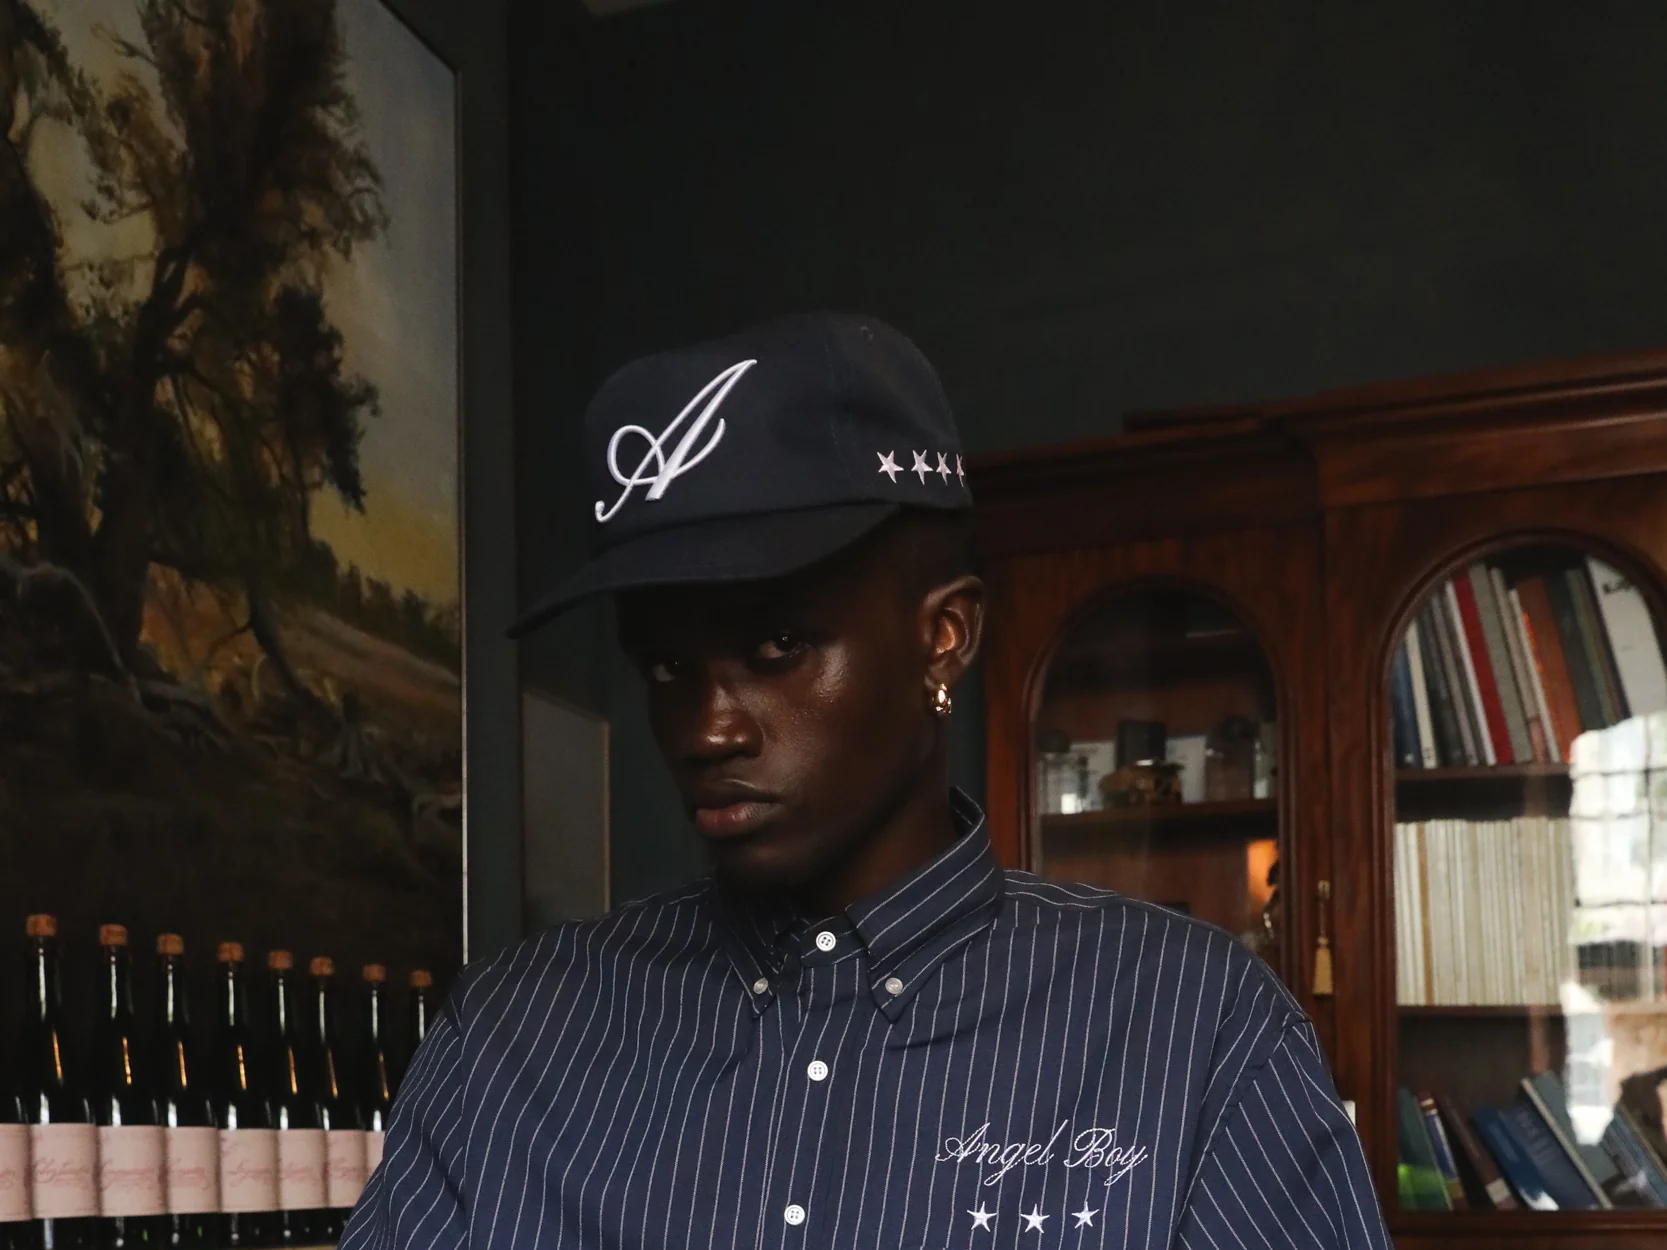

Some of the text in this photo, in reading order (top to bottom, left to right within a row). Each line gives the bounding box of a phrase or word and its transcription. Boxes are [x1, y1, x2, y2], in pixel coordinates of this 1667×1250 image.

[595, 359, 757, 522] A
[935, 1119, 1148, 1186] Angel Boy
